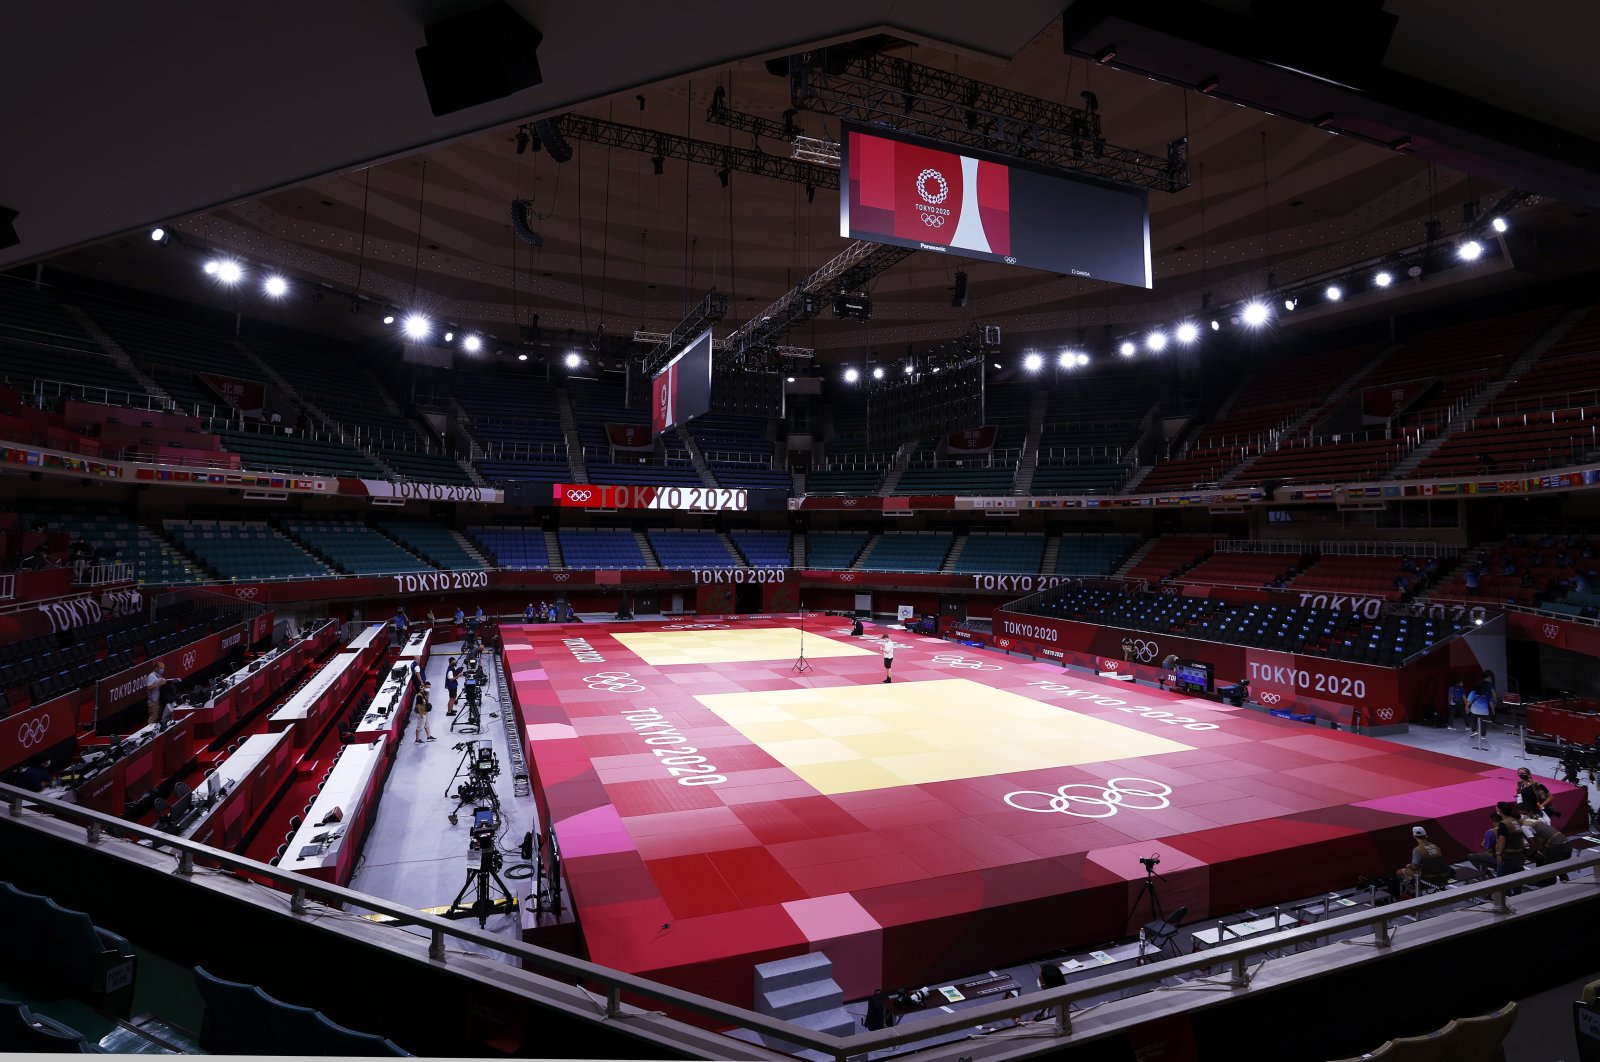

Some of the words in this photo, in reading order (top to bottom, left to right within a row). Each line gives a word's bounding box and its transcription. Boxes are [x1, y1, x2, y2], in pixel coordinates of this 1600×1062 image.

[915, 203, 935, 213] TOKYO
[936, 208, 950, 216] 2020
[920, 242, 946, 252] Panasonic
[967, 440, 977, 448] SE
[389, 481, 443, 499] TOKYO
[446, 486, 482, 501] 2020
[596, 485, 682, 509] TOKYO
[689, 487, 748, 511] 2020
[394, 573, 450, 593] TOKYO
[452, 571, 488, 589] 2020
[691, 570, 744, 584] TOKYO
[747, 569, 785, 584] 2020
[972, 574, 1032, 592] TOKYO
[38, 597, 102, 634] TOKYO
[1300, 593, 1382, 620] TOKYO
[222, 635, 231, 649] TOKYO
[1003, 621, 1033, 637] TOKYO
[1034, 626, 1058, 642] 2020
[109, 679, 132, 703] TOKYO
[1249, 662, 1310, 689] TOKYO
[1315, 673, 1366, 699] 2020
[1025, 680, 1127, 706] TOKYO
[1116, 706, 1220, 731] 2020
[620, 707, 688, 745] TOKYO
[651, 746, 728, 786] 2020
